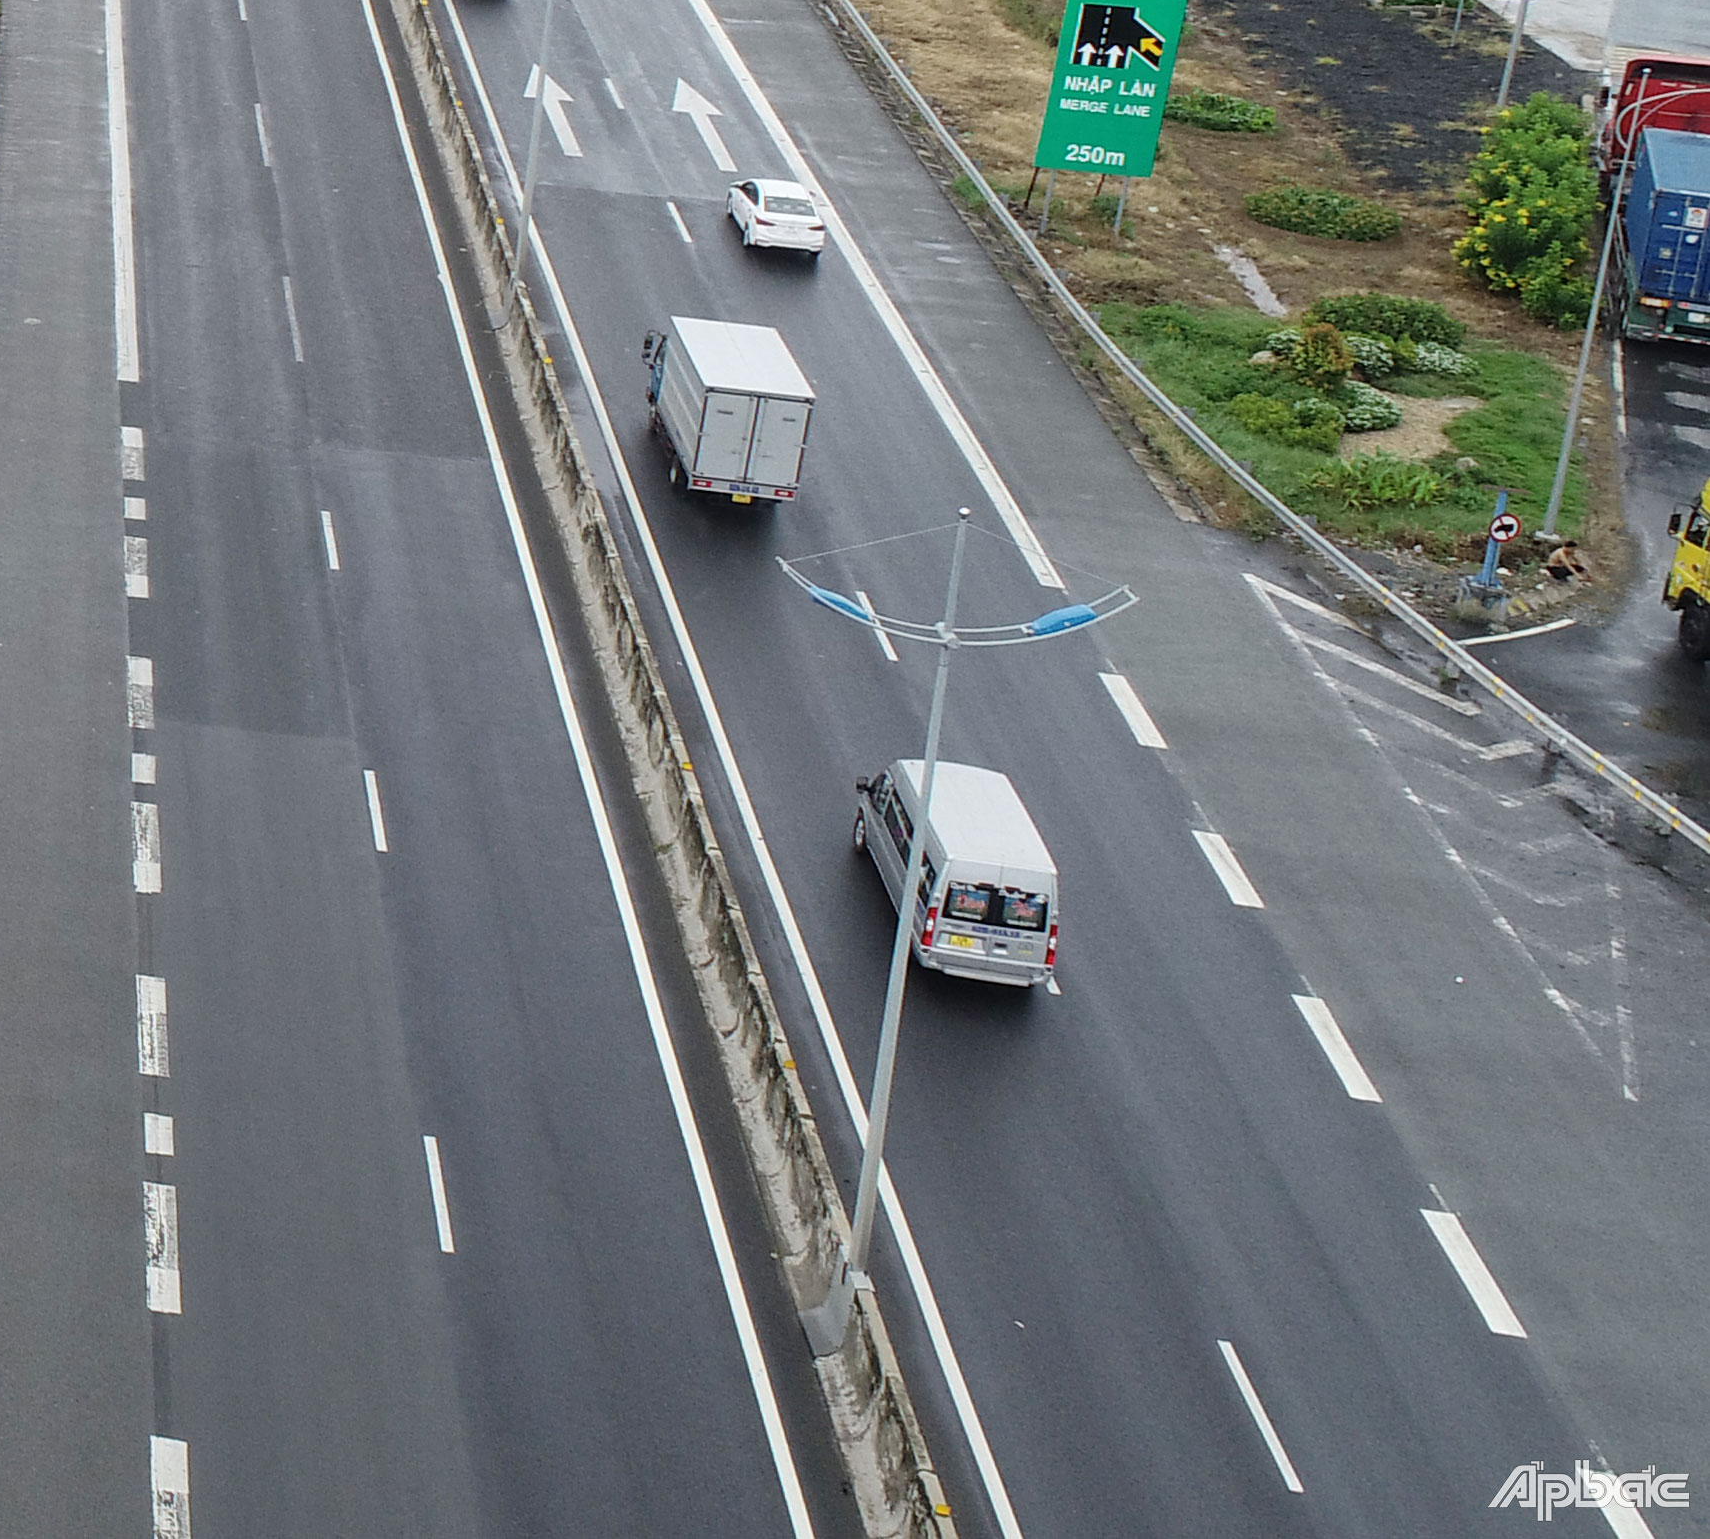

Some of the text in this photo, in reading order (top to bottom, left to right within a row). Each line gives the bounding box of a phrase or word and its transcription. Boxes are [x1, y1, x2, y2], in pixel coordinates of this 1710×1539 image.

[1063, 74, 1157, 98] NHẬP LÀN
[1059, 98, 1151, 118] MERGE LANE
[1064, 143, 1126, 167] 250m
